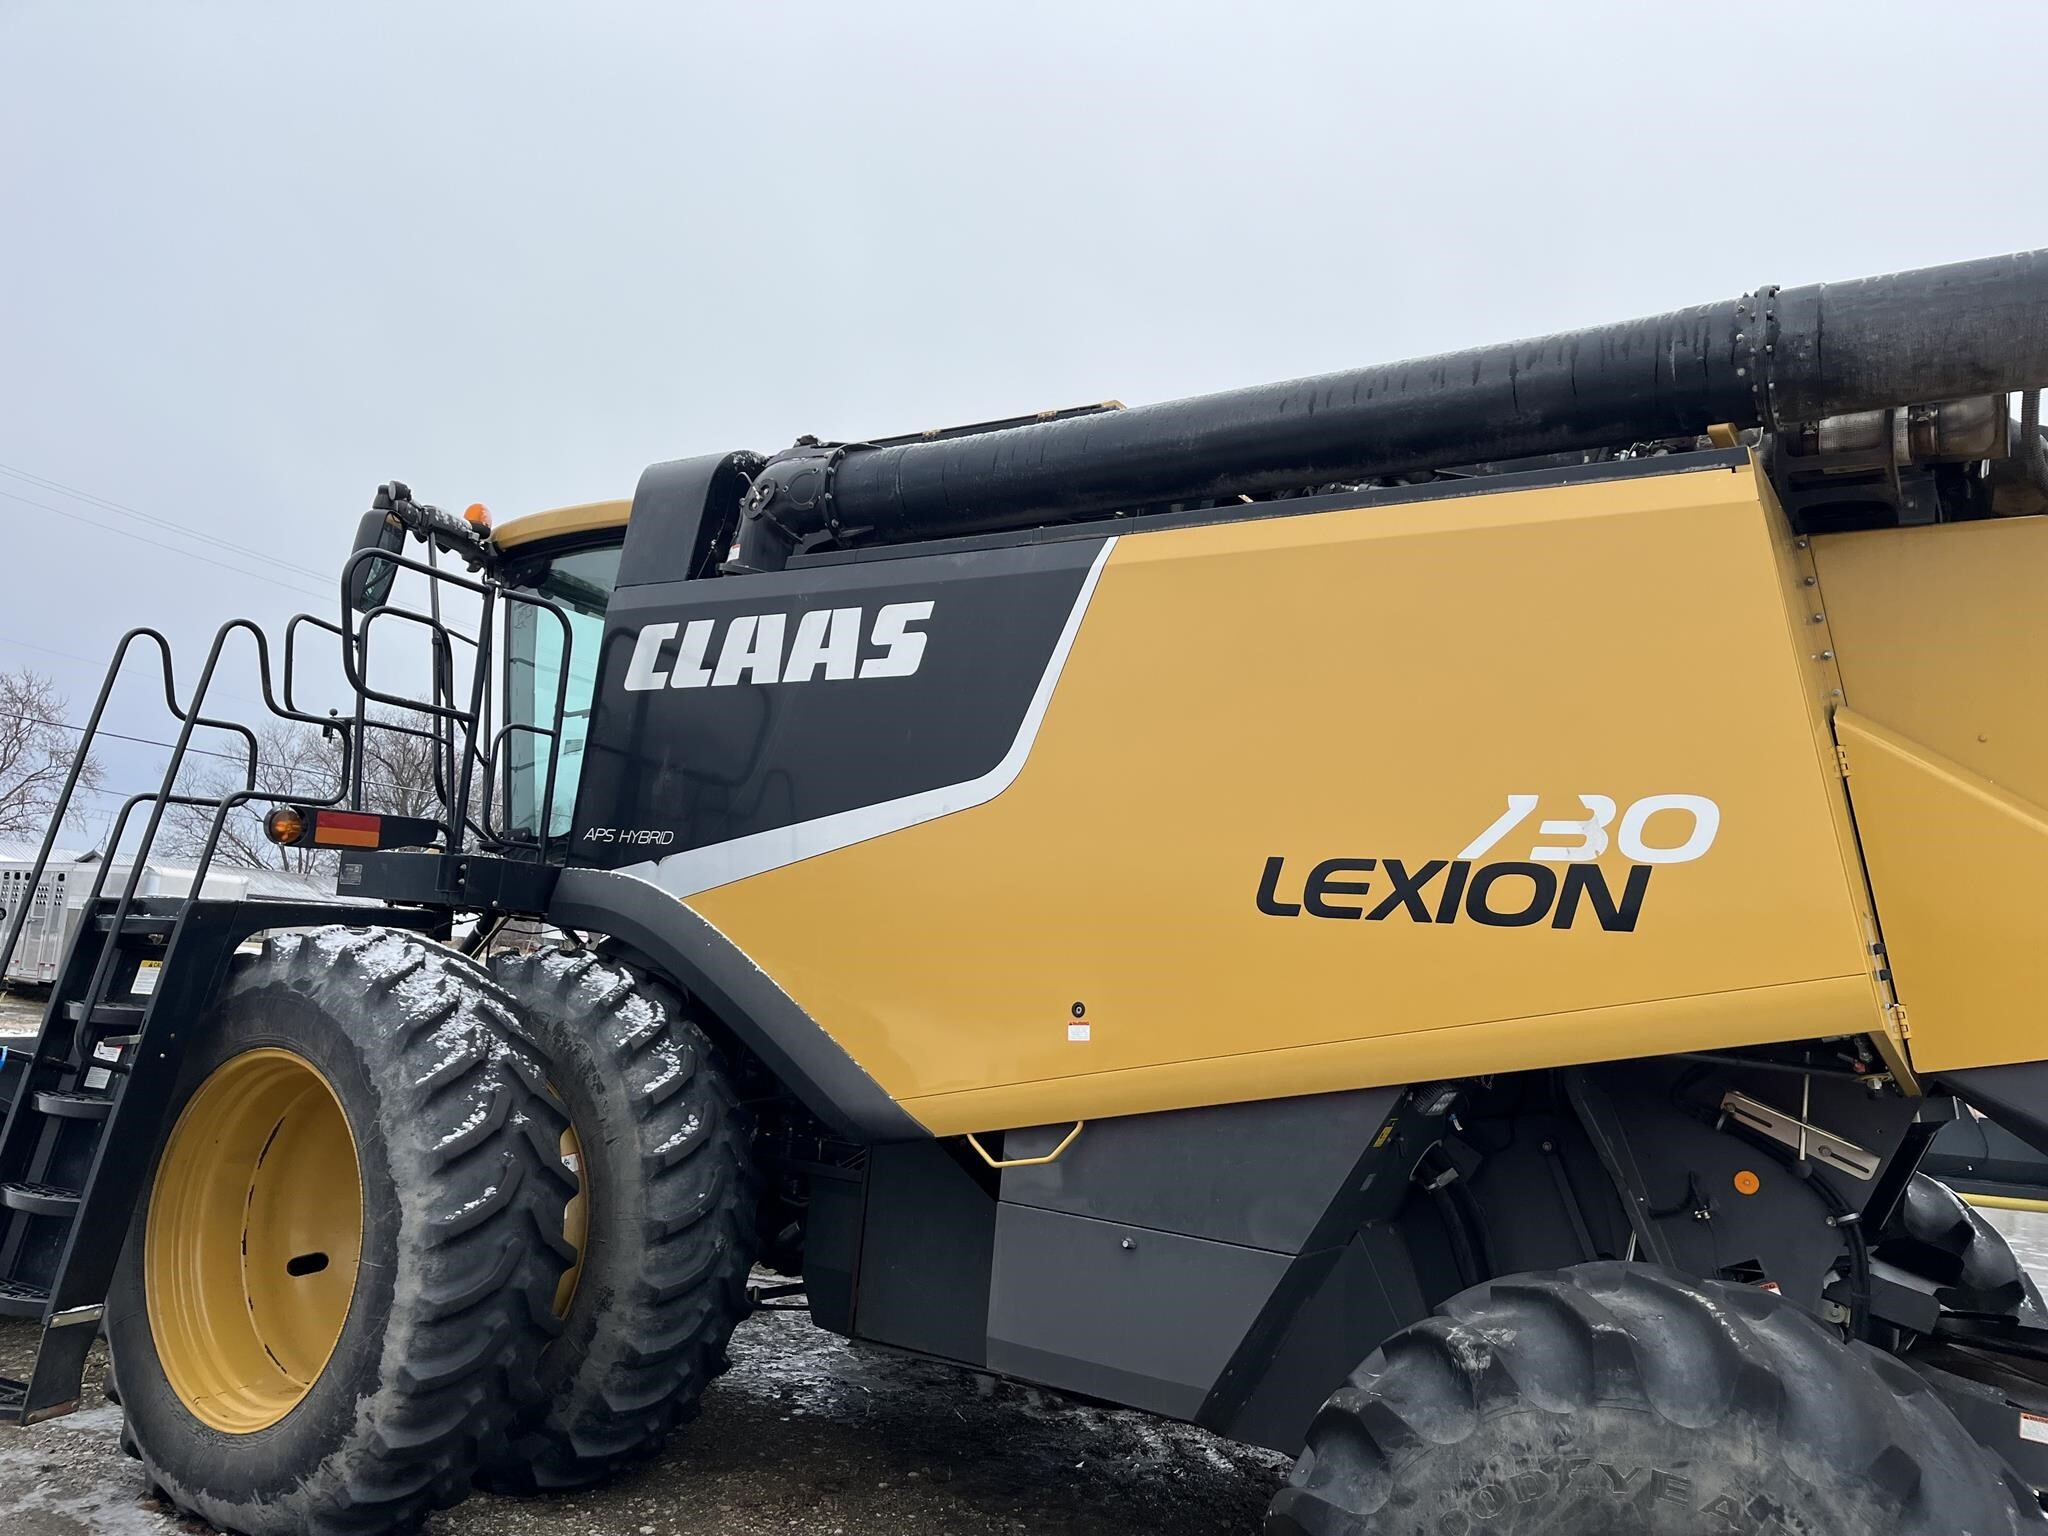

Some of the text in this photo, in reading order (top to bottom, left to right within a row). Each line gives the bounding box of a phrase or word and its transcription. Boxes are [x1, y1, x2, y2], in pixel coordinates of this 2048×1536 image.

[624, 601, 935, 691] CLAAS
[583, 828, 674, 844] APS HYBRID
[1257, 857, 1652, 932] LEXION
